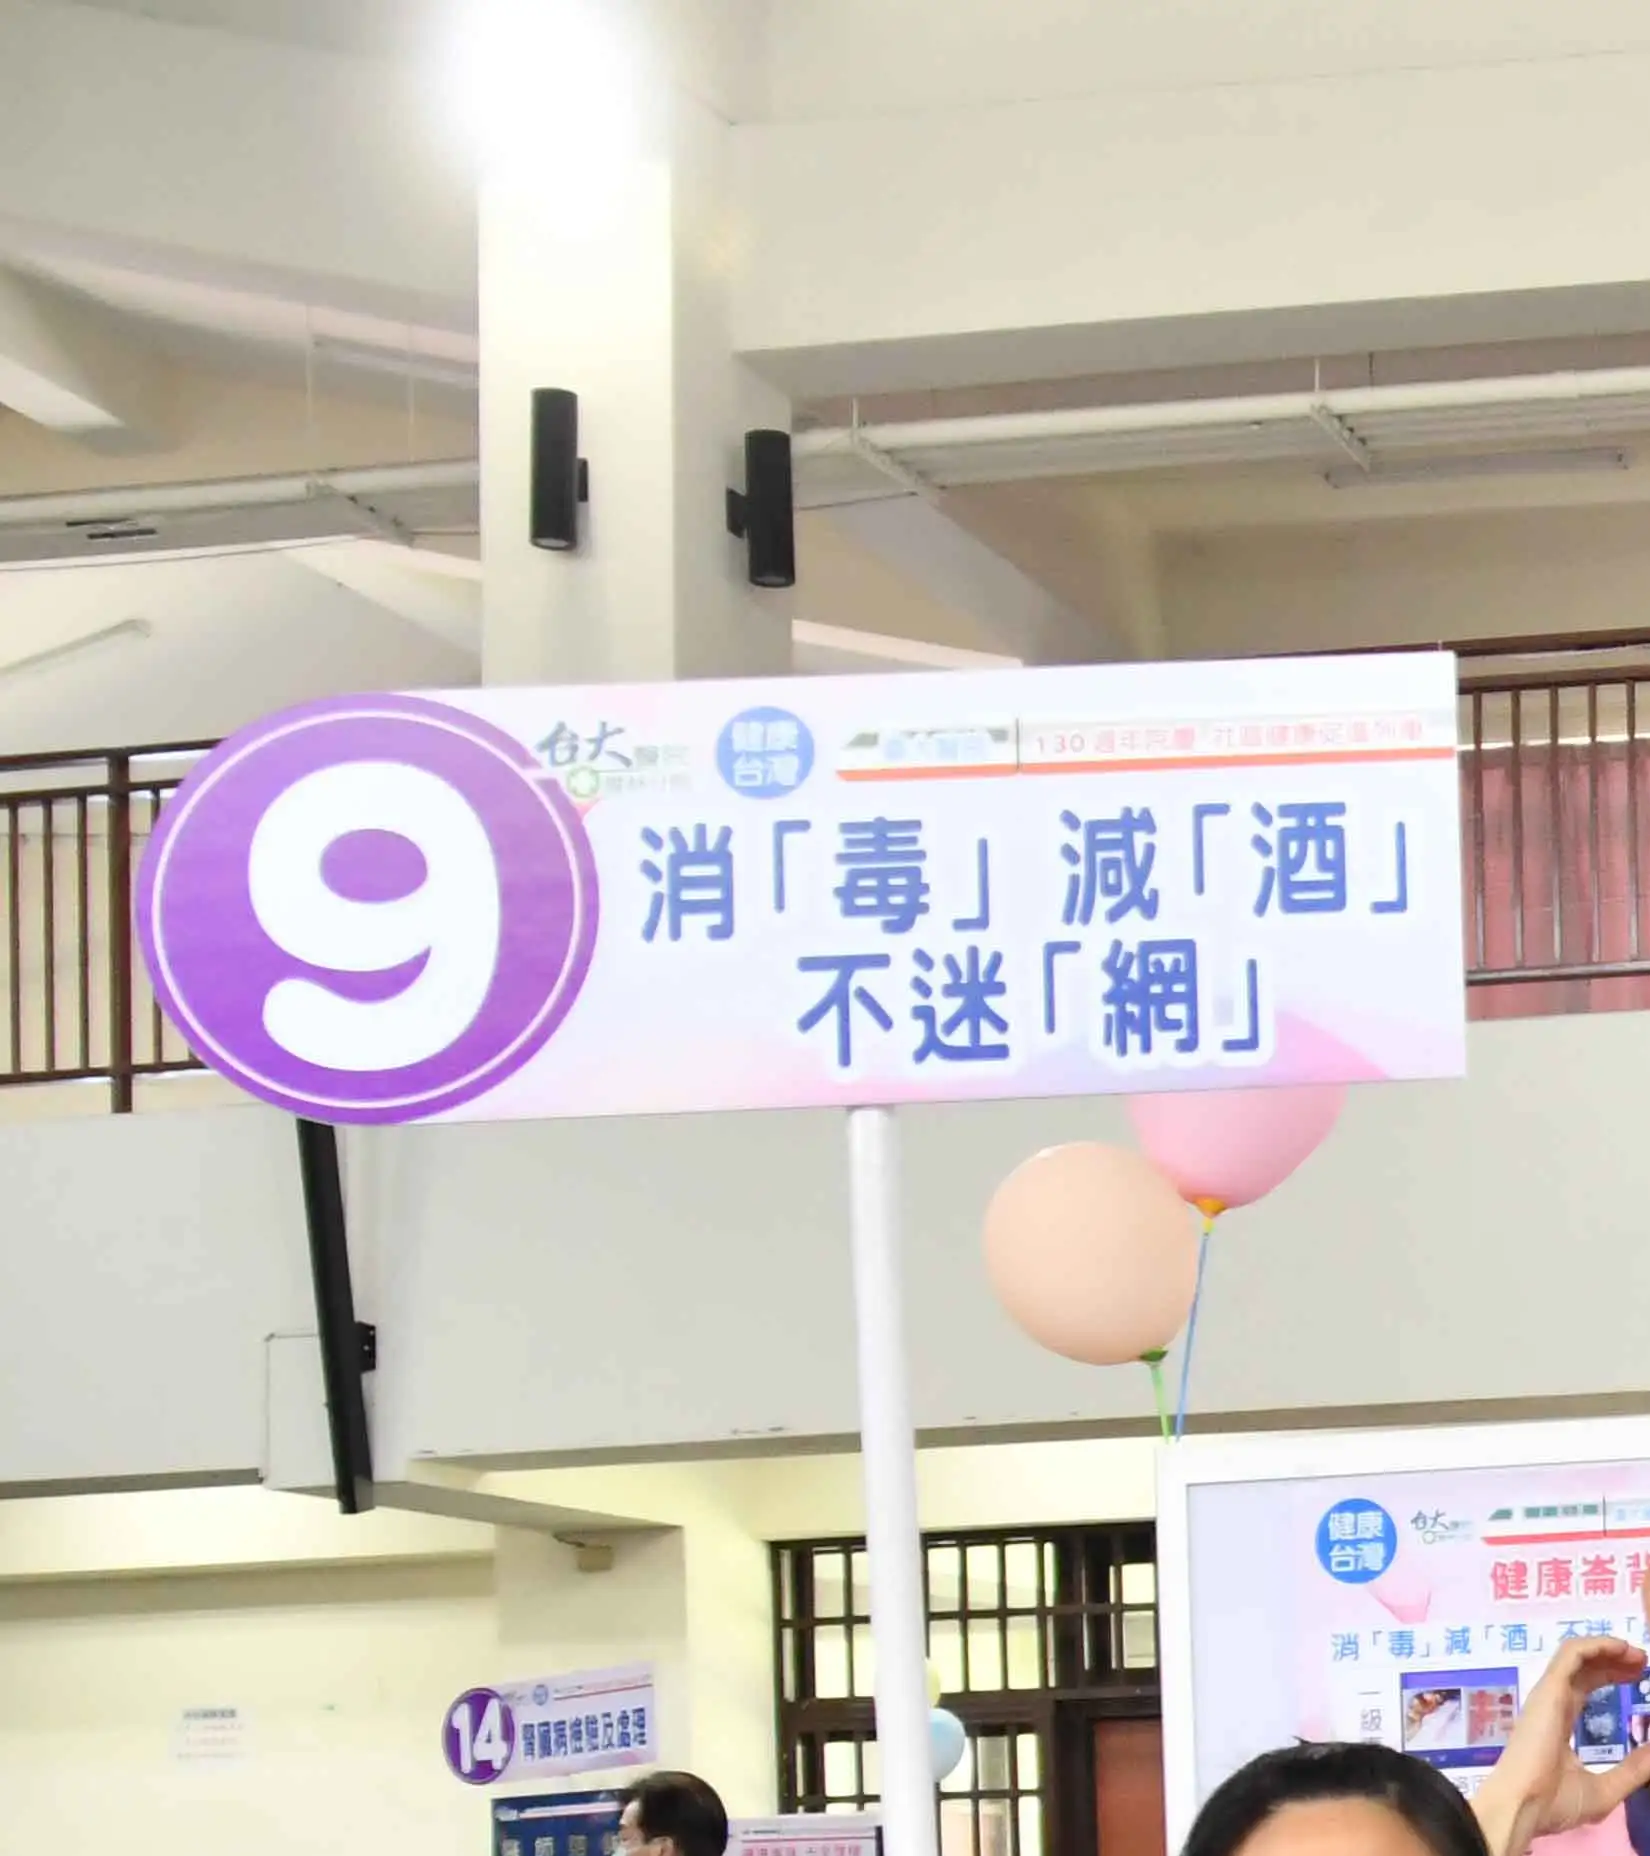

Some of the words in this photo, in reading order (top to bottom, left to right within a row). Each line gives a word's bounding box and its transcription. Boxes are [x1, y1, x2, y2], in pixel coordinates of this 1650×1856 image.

[1036, 732, 1085, 754] 130
[640, 801, 1408, 942] 消「毒」減「酒」
[248, 760, 501, 1072] 9
[797, 938, 1259, 1068] 不迷「網」
[1328, 1511, 1385, 1541] 健康
[1329, 1542, 1385, 1573] 台灣
[452, 1697, 508, 1775] 14
